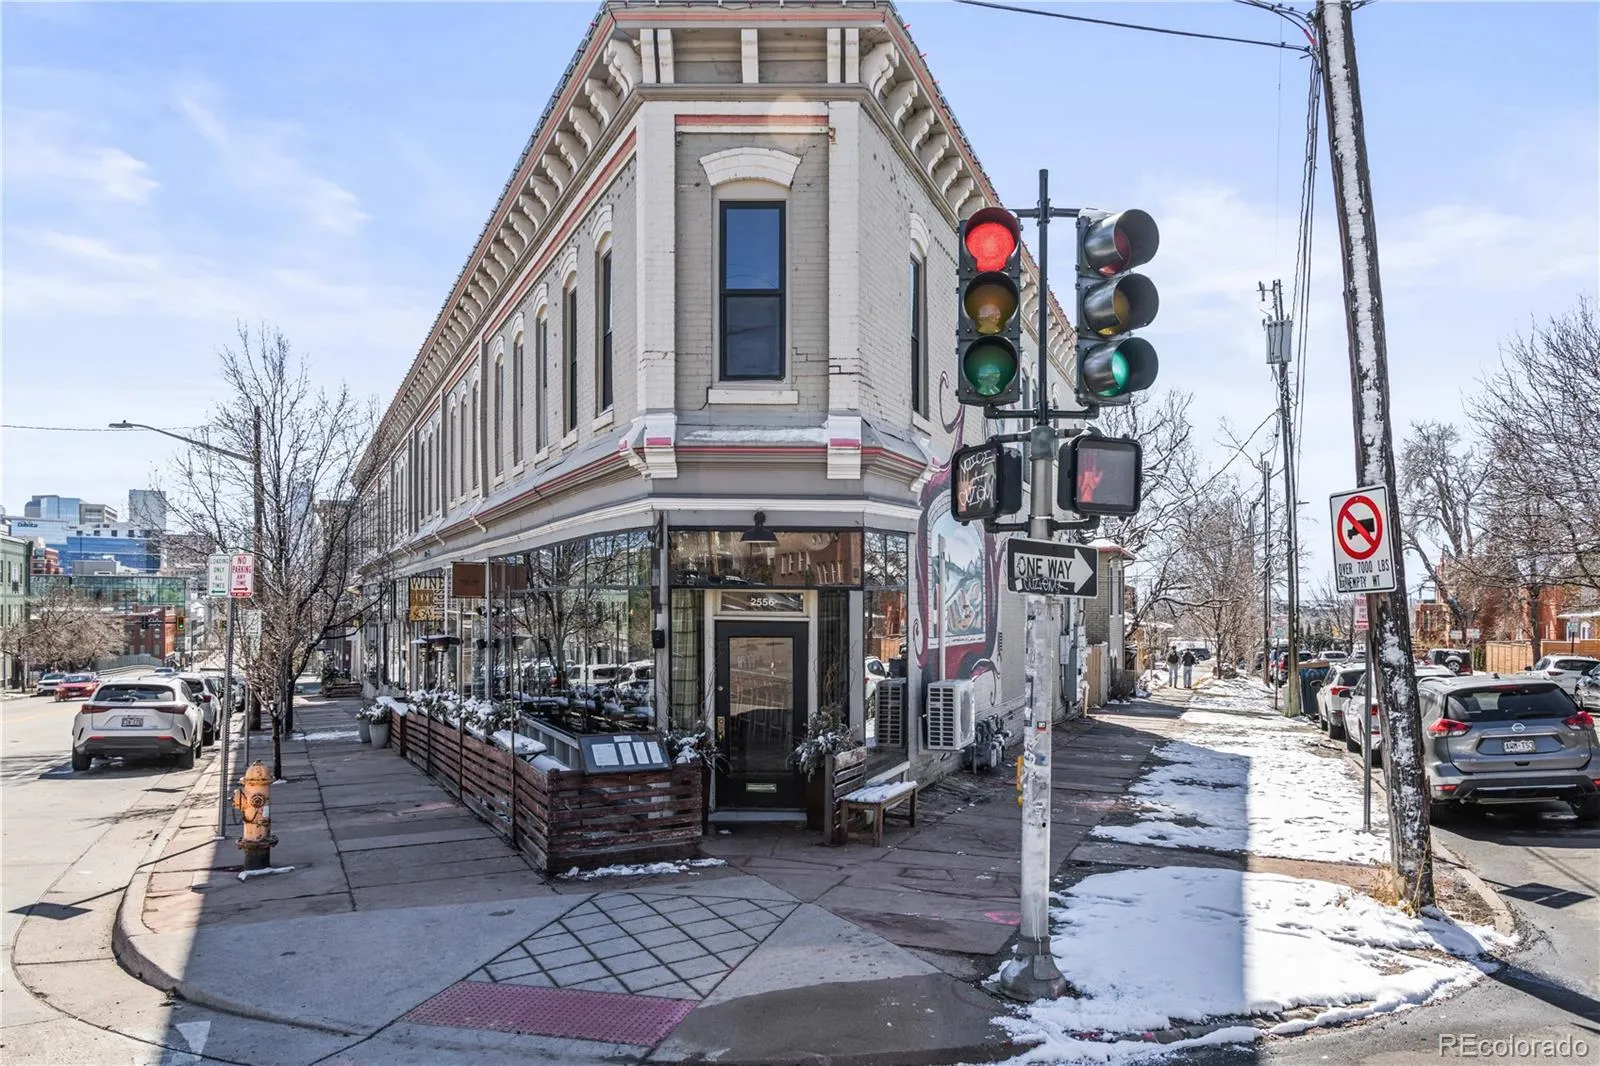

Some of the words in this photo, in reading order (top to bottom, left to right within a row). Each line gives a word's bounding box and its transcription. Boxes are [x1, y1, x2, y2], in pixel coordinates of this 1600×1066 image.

[237, 556, 247, 565] NO
[232, 565, 252, 573] PARKING
[1017, 556, 1043, 577] ONE
[1047, 559, 1073, 580] WAY
[1338, 563, 1353, 575] OVER
[1357, 560, 1373, 574] 7000
[1377, 559, 1390, 572] LBS
[411, 578, 445, 589] WINE
[750, 597, 775, 607] 2556
